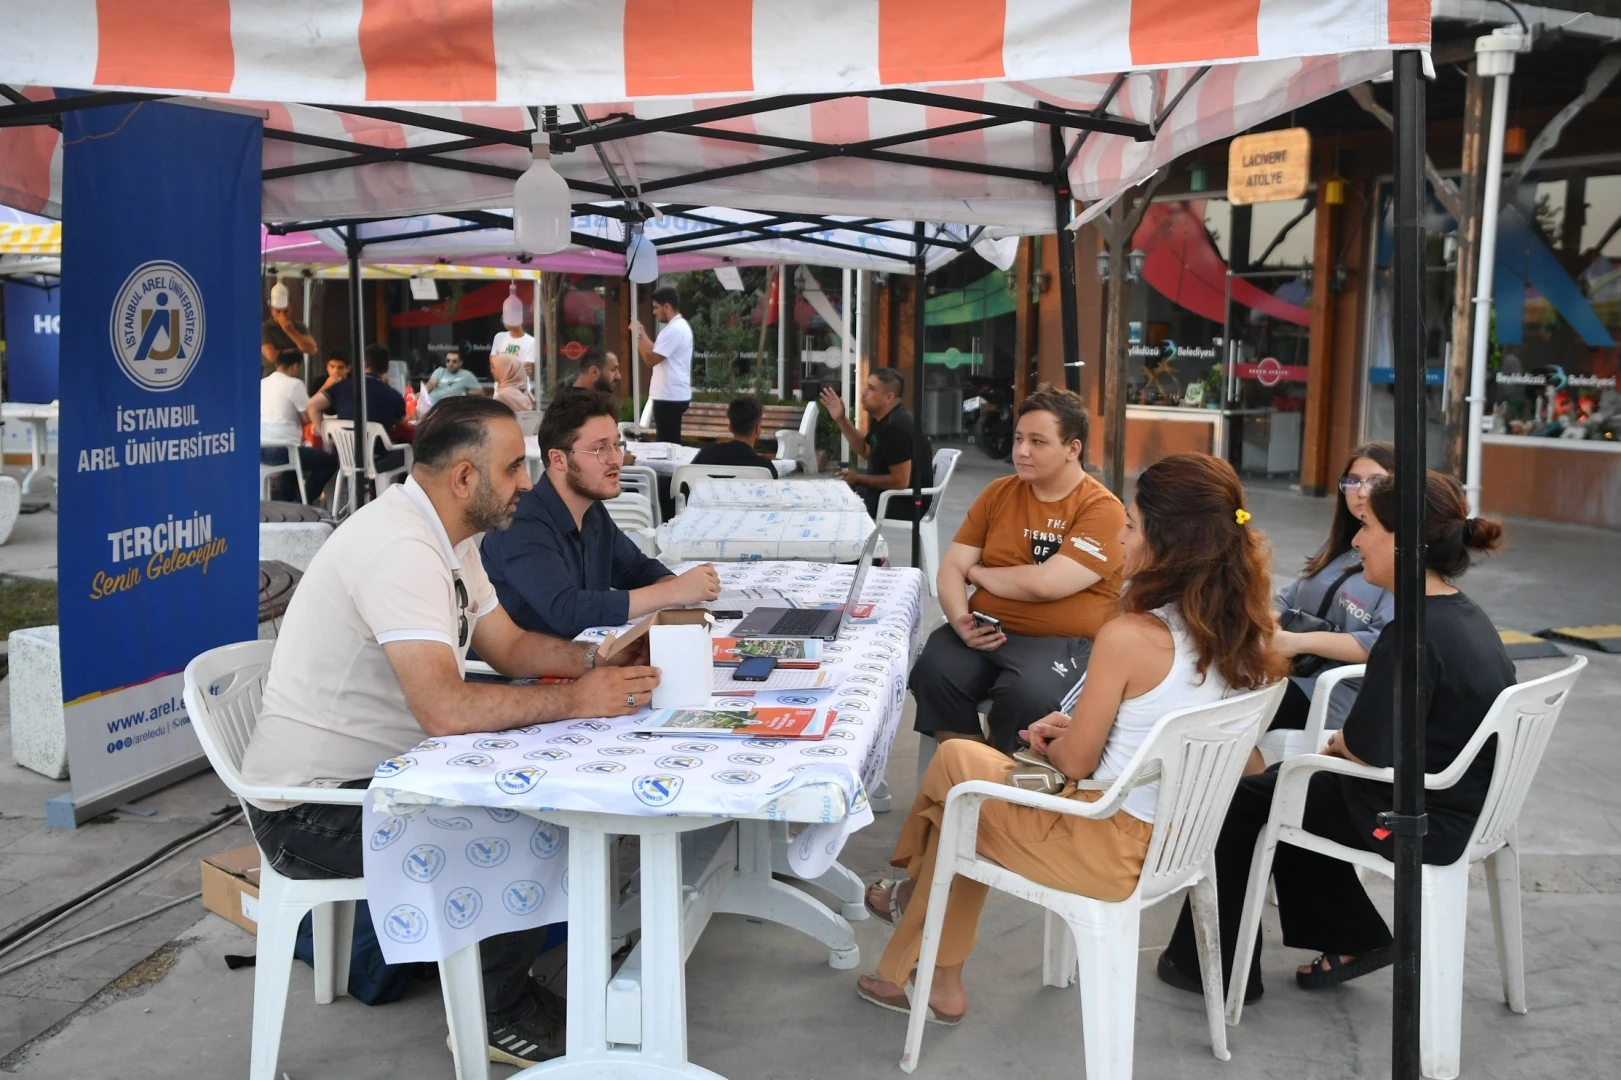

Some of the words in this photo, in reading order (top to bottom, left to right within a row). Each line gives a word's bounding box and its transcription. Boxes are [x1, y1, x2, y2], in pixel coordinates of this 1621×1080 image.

[141, 276, 167, 295] AREL
[1128, 345, 1159, 357] ylikdüzü
[1177, 346, 1215, 358] Belediyesi
[116, 404, 199, 433] İSTANBUL
[77, 446, 120, 473] AREL
[125, 427, 235, 466] ÜNİVERSİTESİ
[107, 510, 212, 563] TERCİHİN
[1047, 518, 1067, 529] THE
[1033, 545, 1050, 556] OF
[89, 566, 141, 600] Senin
[146, 537, 228, 580] Geleceğin
[107, 697, 186, 734] www.arel.e
